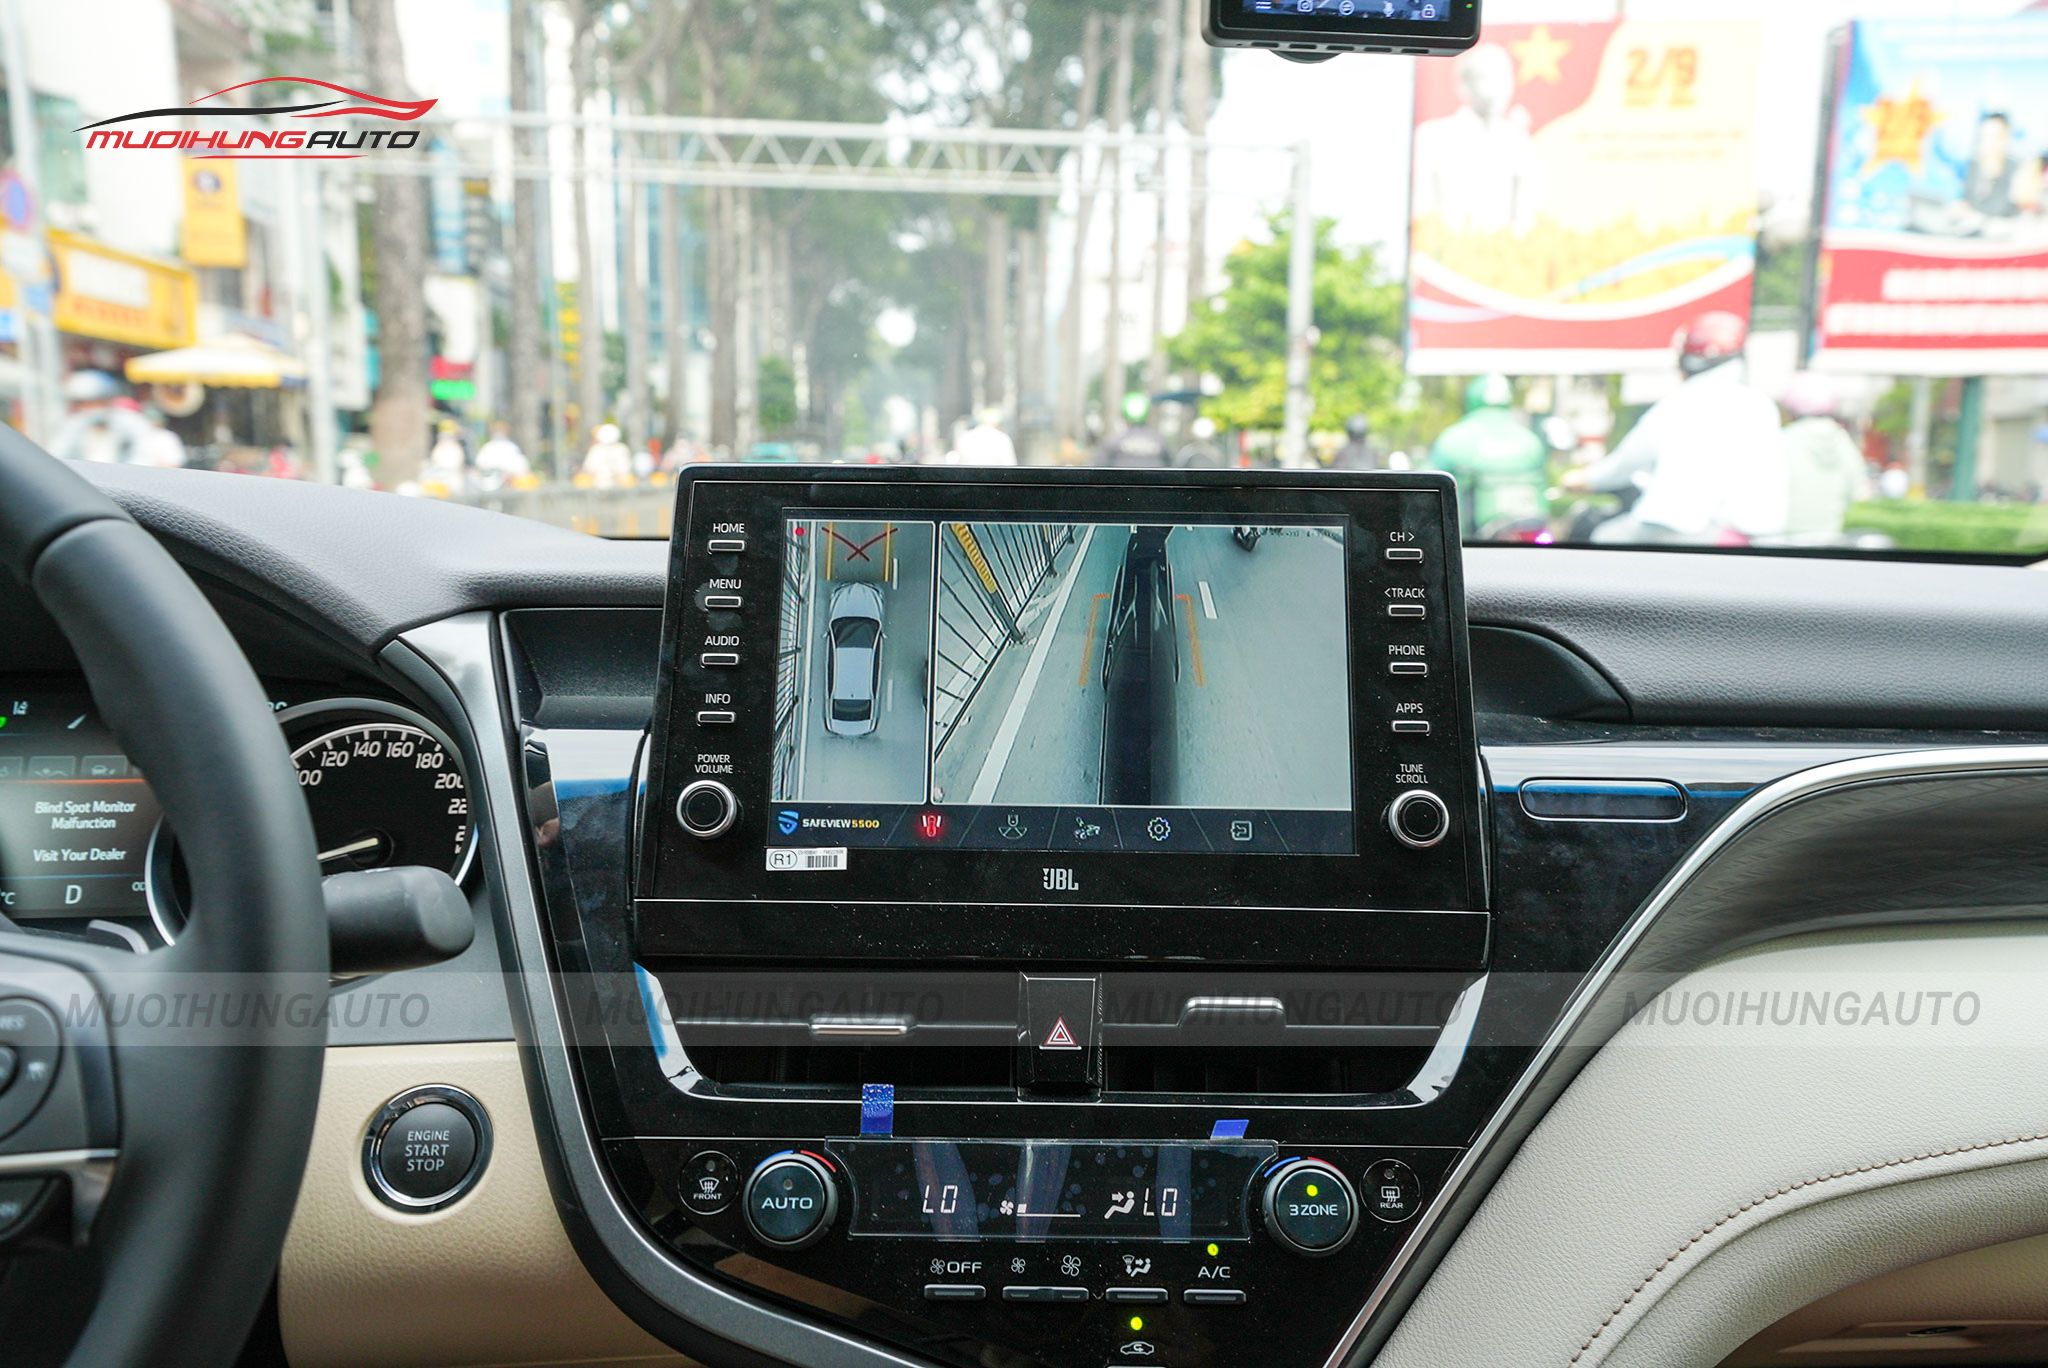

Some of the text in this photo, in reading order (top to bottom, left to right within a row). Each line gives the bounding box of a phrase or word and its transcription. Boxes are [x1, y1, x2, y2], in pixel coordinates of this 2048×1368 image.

[712, 522, 745, 534] HOME
[709, 578, 742, 590] MENU
[704, 635, 740, 647] AUDIO
[1388, 644, 1426, 656] PHONE
[705, 693, 731, 704] INFO
[1395, 702, 1424, 714] APPS
[353, 741, 382, 758] 140
[386, 742, 415, 759] 160
[321, 751, 349, 768] 120
[415, 753, 443, 769] 180
[697, 753, 731, 764] POWER
[694, 764, 733, 774] VOLUME
[1399, 763, 1424, 773] TUNE
[298, 770, 322, 786] 00
[1395, 773, 1429, 784] SCROLL
[35, 801, 136, 815] Blind Spot Monitor
[51, 817, 116, 830] Malfunction
[33, 847, 126, 862] Visit Your Dealer
[774, 853, 791, 866] R1
[1042, 868, 1079, 891] JBL
[65, 884, 82, 905] D
[407, 1130, 450, 1142] ENGINE
[405, 1143, 450, 1157] START
[407, 1158, 445, 1172] STOP
[692, 1192, 723, 1200] FRONT
[761, 1197, 813, 1210] AUTO
[1289, 1204, 1339, 1216] 3 ZONE
[1379, 1202, 1404, 1210] REAR
[947, 1261, 982, 1274] OFF
[1197, 1265, 1231, 1279] A/C
